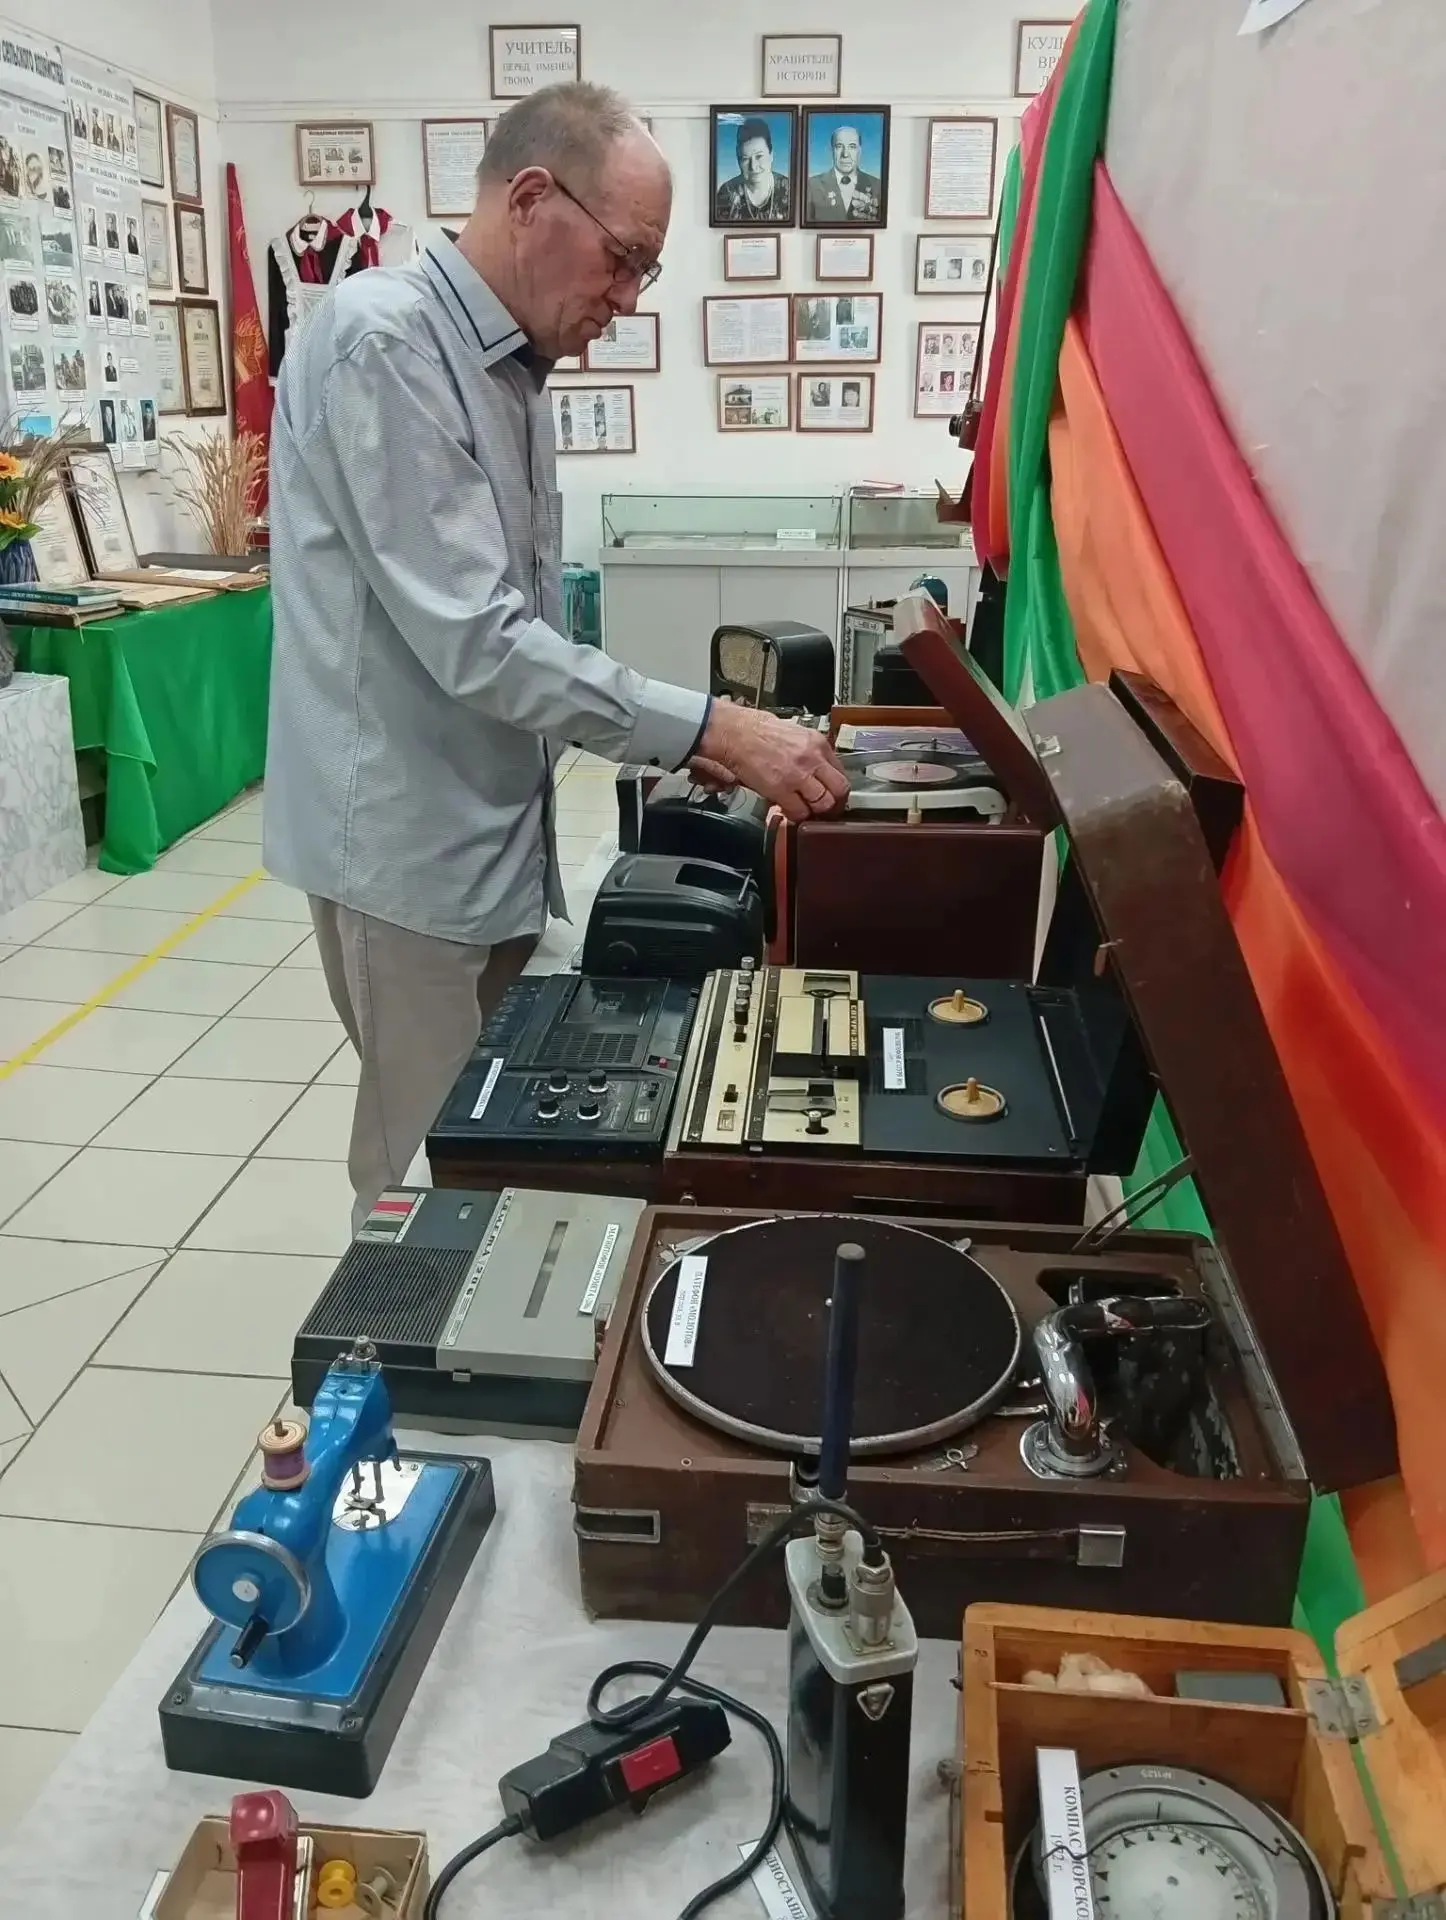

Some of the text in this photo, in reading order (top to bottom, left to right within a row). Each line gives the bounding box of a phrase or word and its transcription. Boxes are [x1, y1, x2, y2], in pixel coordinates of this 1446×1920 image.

[505, 40, 576, 56] УЧИТЕЛЬ,
[769, 54, 834, 65] ХРАНИТЕЛИ
[777, 71, 826, 81] ИСТОРИИ
[690, 1271, 703, 1305] ПАТЕФОН
[1063, 1785, 1082, 1849] КОМПАС
